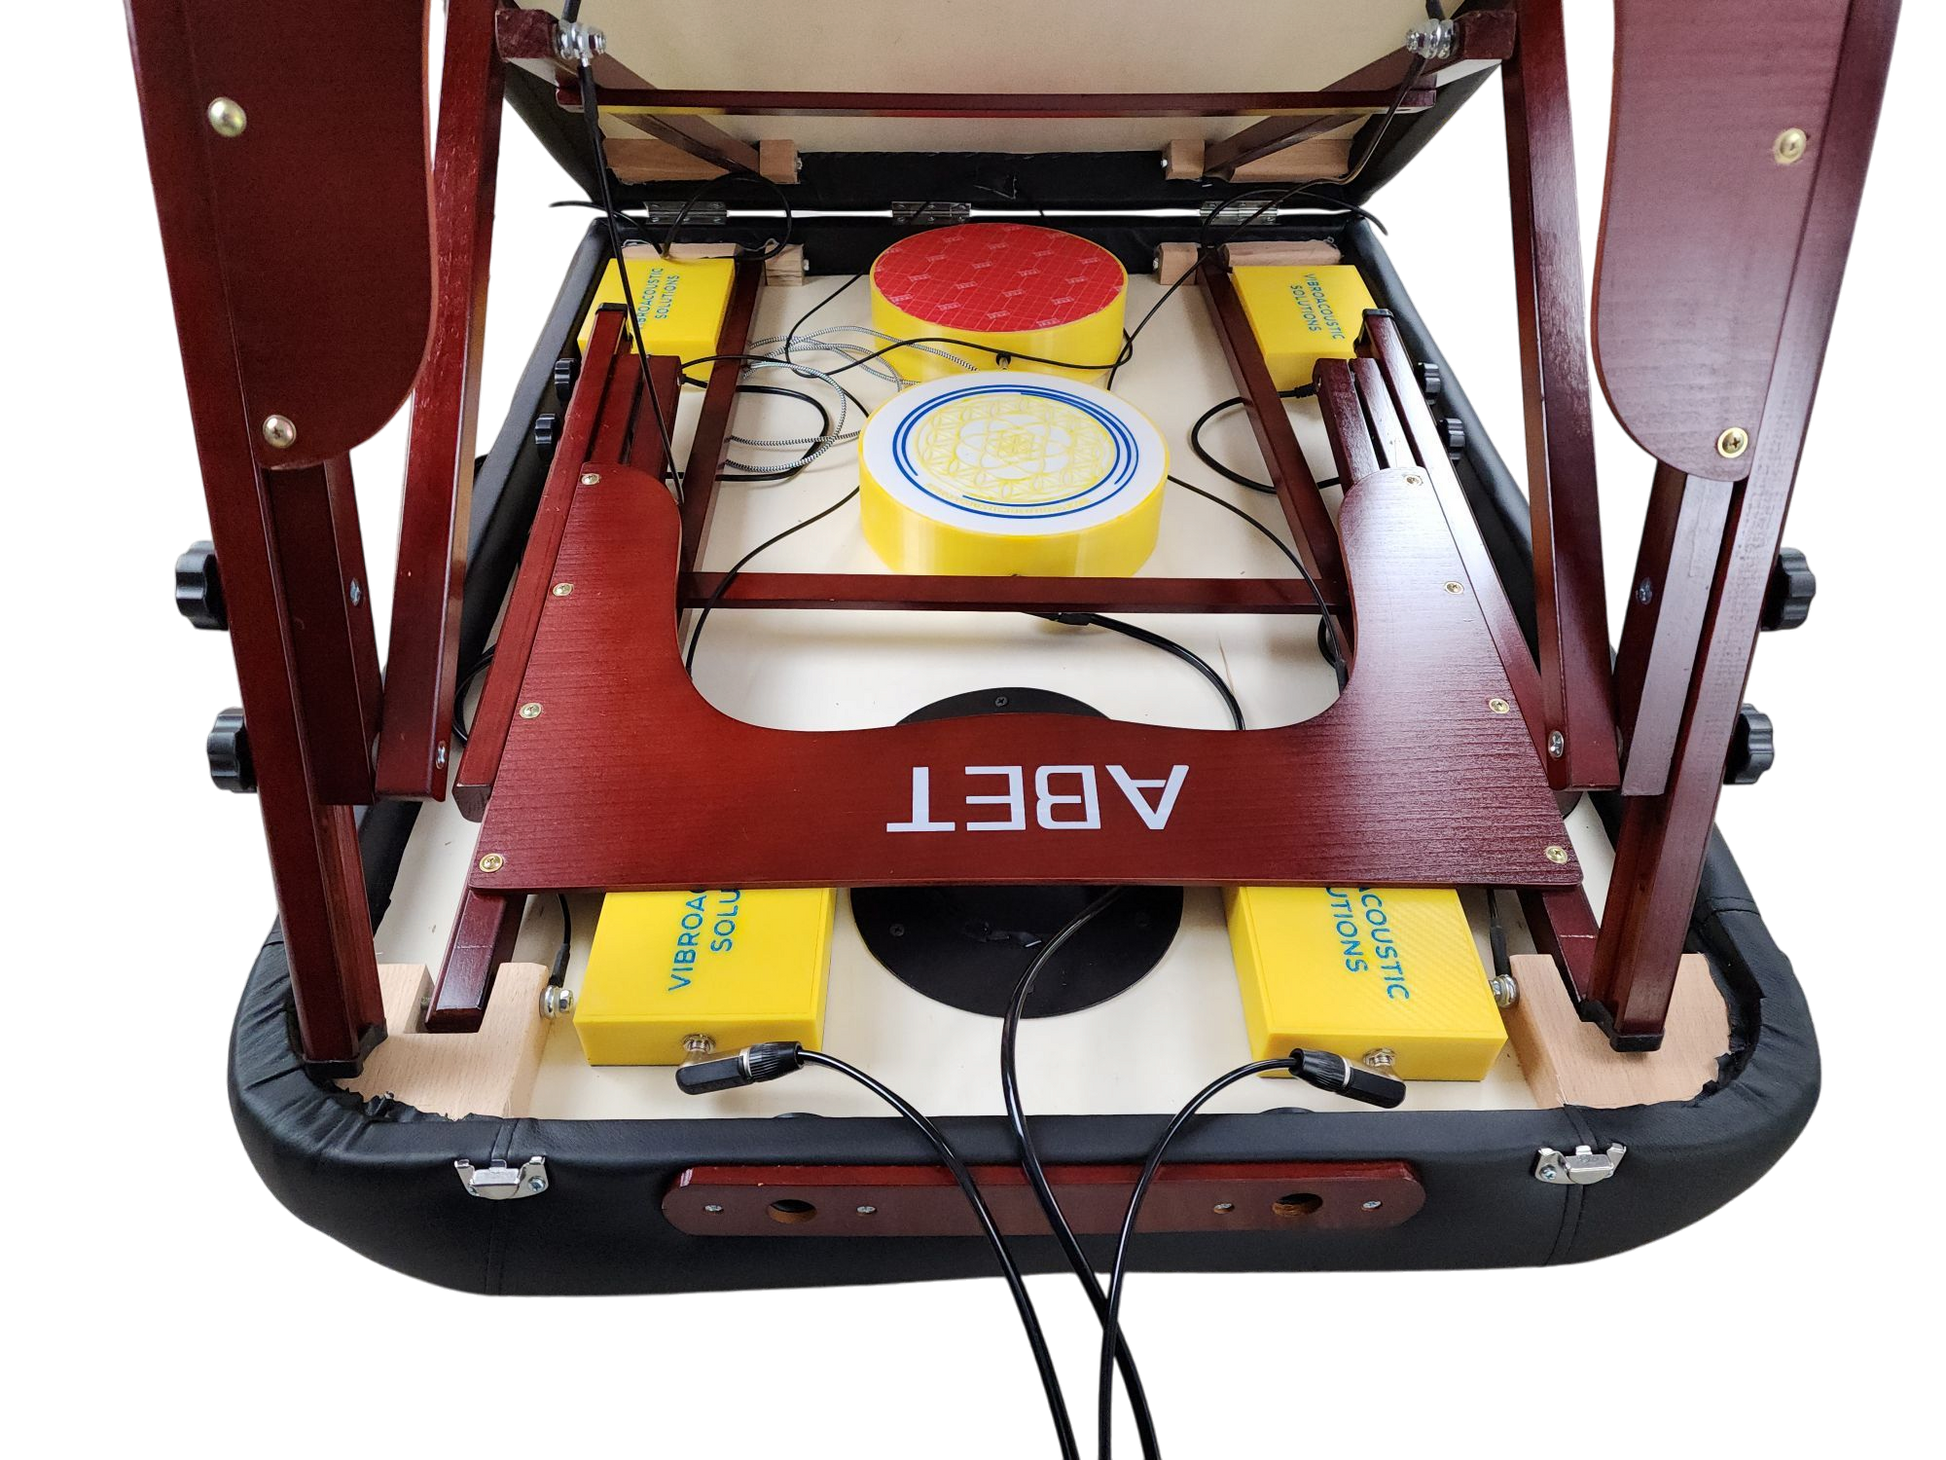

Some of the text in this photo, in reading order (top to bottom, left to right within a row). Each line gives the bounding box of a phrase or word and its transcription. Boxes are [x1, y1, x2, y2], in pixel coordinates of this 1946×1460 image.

[636, 268, 664, 329] BROACOUSTIC
[655, 275, 680, 319] SOLUTIONS
[1290, 285, 1322, 332] SOLUTIONS
[1304, 273, 1345, 340] VIBROACOUSTIC
[886, 765, 1190, 832] ABET
[668, 889, 707, 991] VIBROA
[710, 888, 741, 952] SOLU
[1359, 887, 1410, 999] COUSTIC
